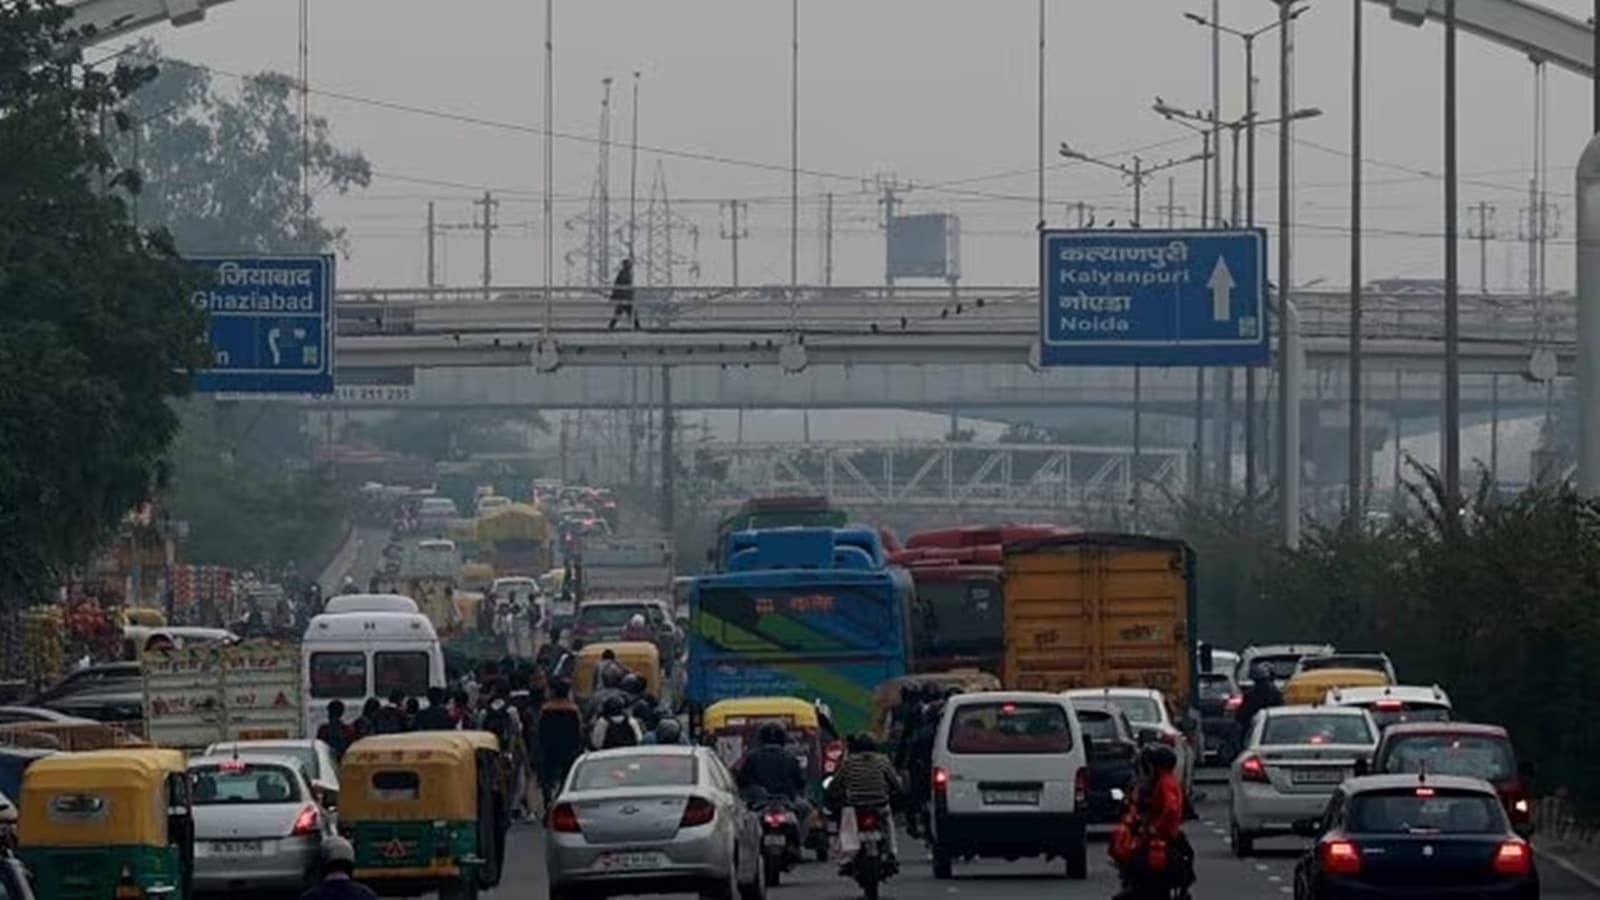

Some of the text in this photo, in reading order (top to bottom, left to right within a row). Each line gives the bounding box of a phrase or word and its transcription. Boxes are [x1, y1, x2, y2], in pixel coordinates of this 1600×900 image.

[1059, 241, 1189, 269] कल्याणपुरी
[217, 261, 312, 287] जियाबाद
[1060, 268, 1190, 286] Kalyanpuri
[190, 290, 314, 310] Ghaziabad
[1059, 289, 1133, 312] नोएडा
[1060, 315, 1129, 331] Noida
